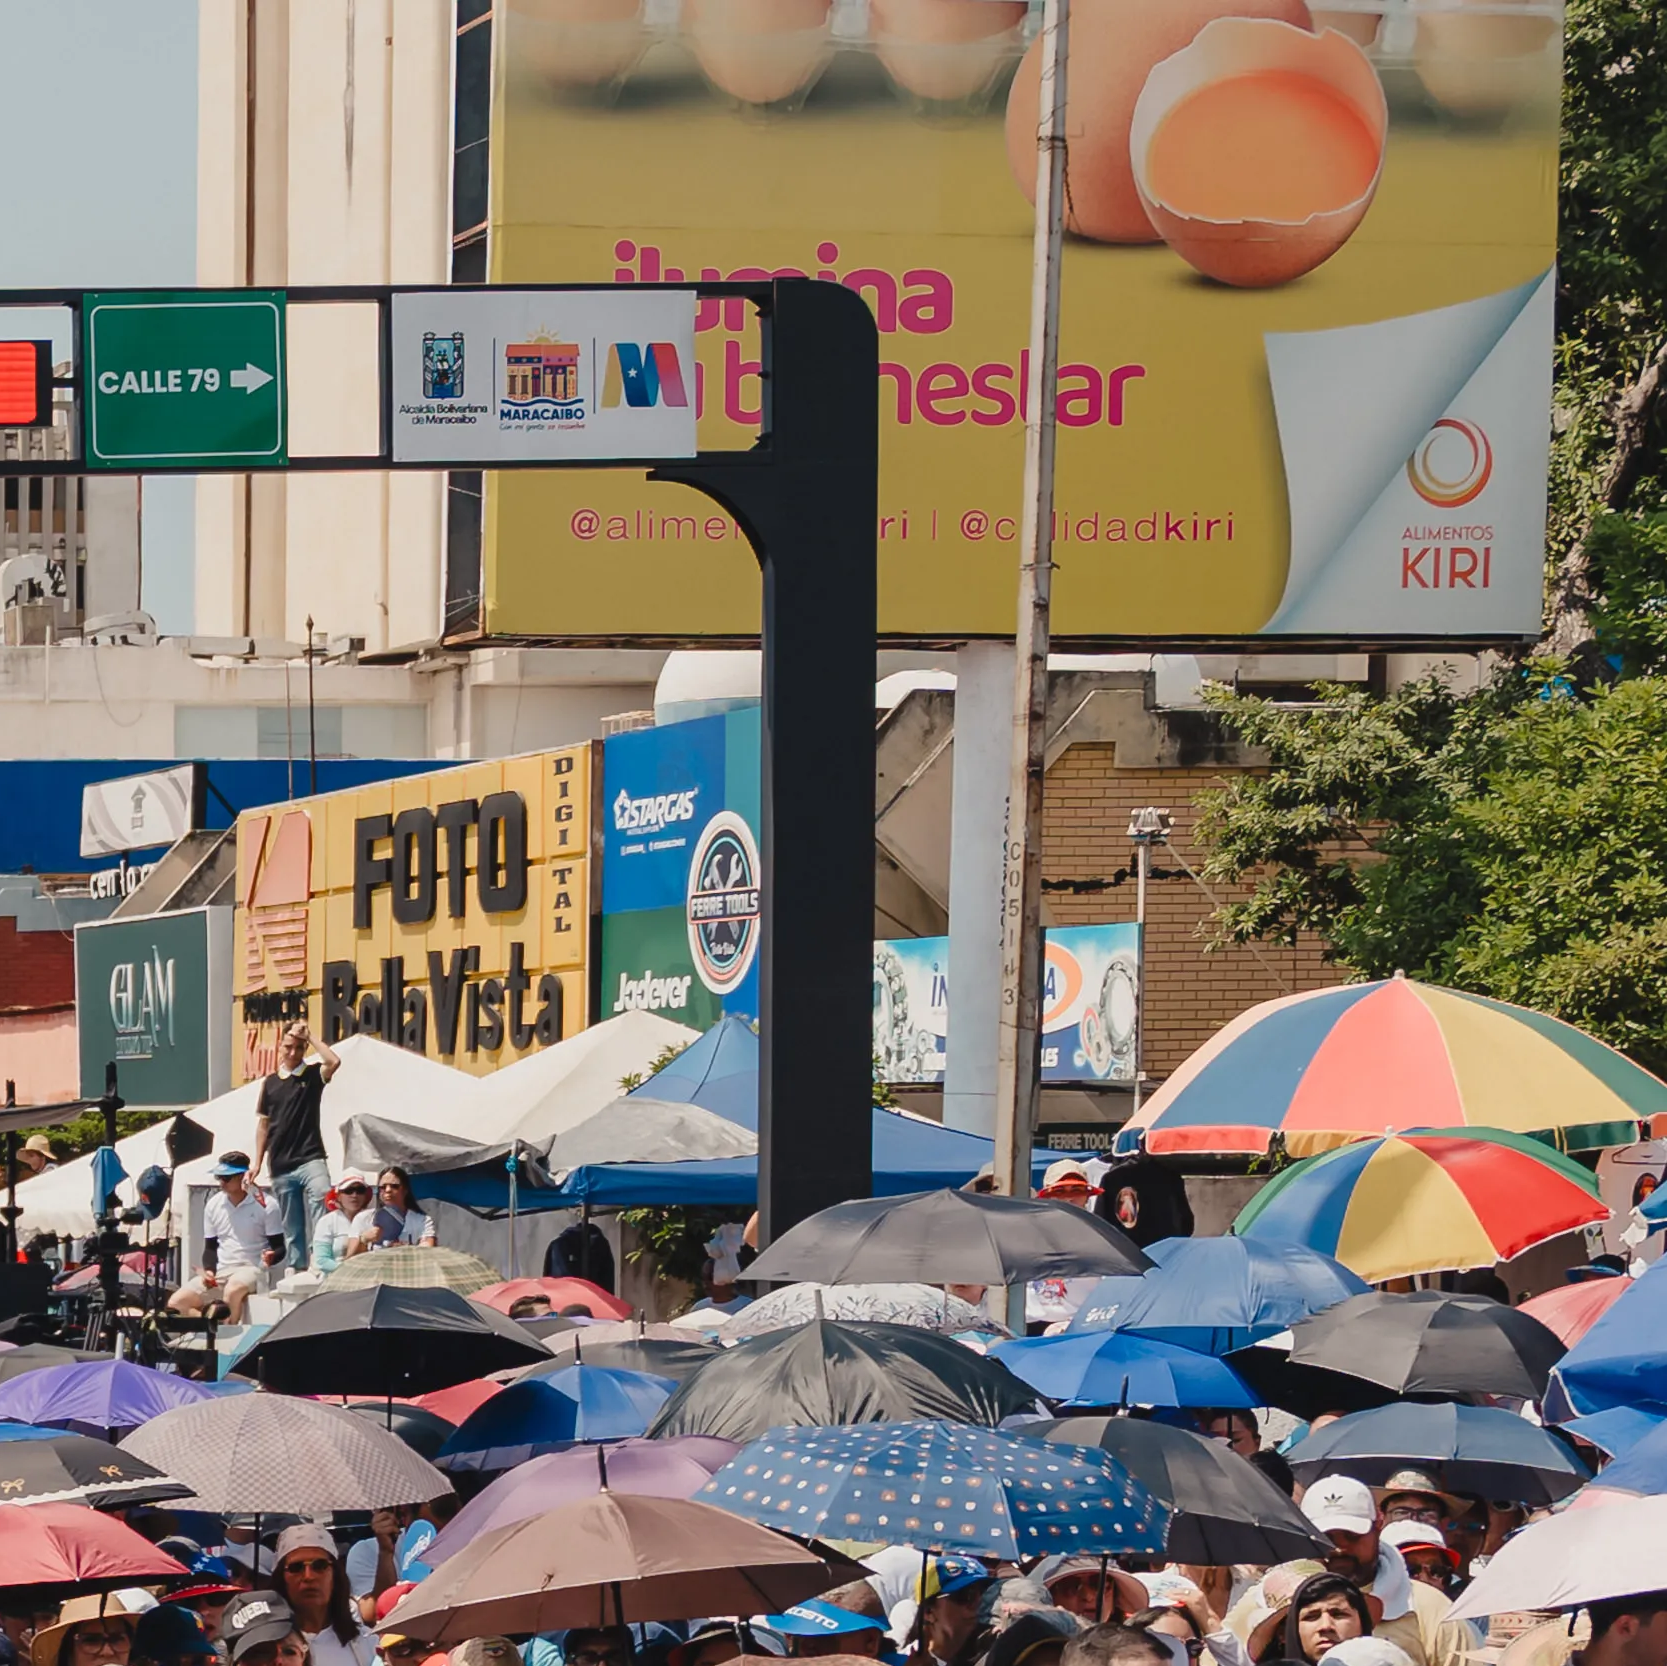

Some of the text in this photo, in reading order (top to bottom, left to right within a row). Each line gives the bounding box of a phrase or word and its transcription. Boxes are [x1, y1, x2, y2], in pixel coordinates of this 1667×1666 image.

[98, 367, 221, 395] CALLE 79
[425, 415, 477, 425] Maracaibo
[500, 408, 585, 421] MARACAIBO
[959, 509, 1236, 543] @clidadkiri
[1401, 525, 1493, 542] ALIMENTOS
[1400, 546, 1492, 590] KIRI
[628, 790, 697, 829] STARGAS
[352, 790, 528, 929] FOTO
[691, 891, 760, 918] FERRE TOOLS
[110, 944, 175, 1048] GLAM
[613, 969, 692, 1013] Jadever
[1048, 1131, 1113, 1150] FERRE TOOL
[230, 1600, 270, 1630] QUEEN
[783, 1605, 841, 1631] KOSTO
